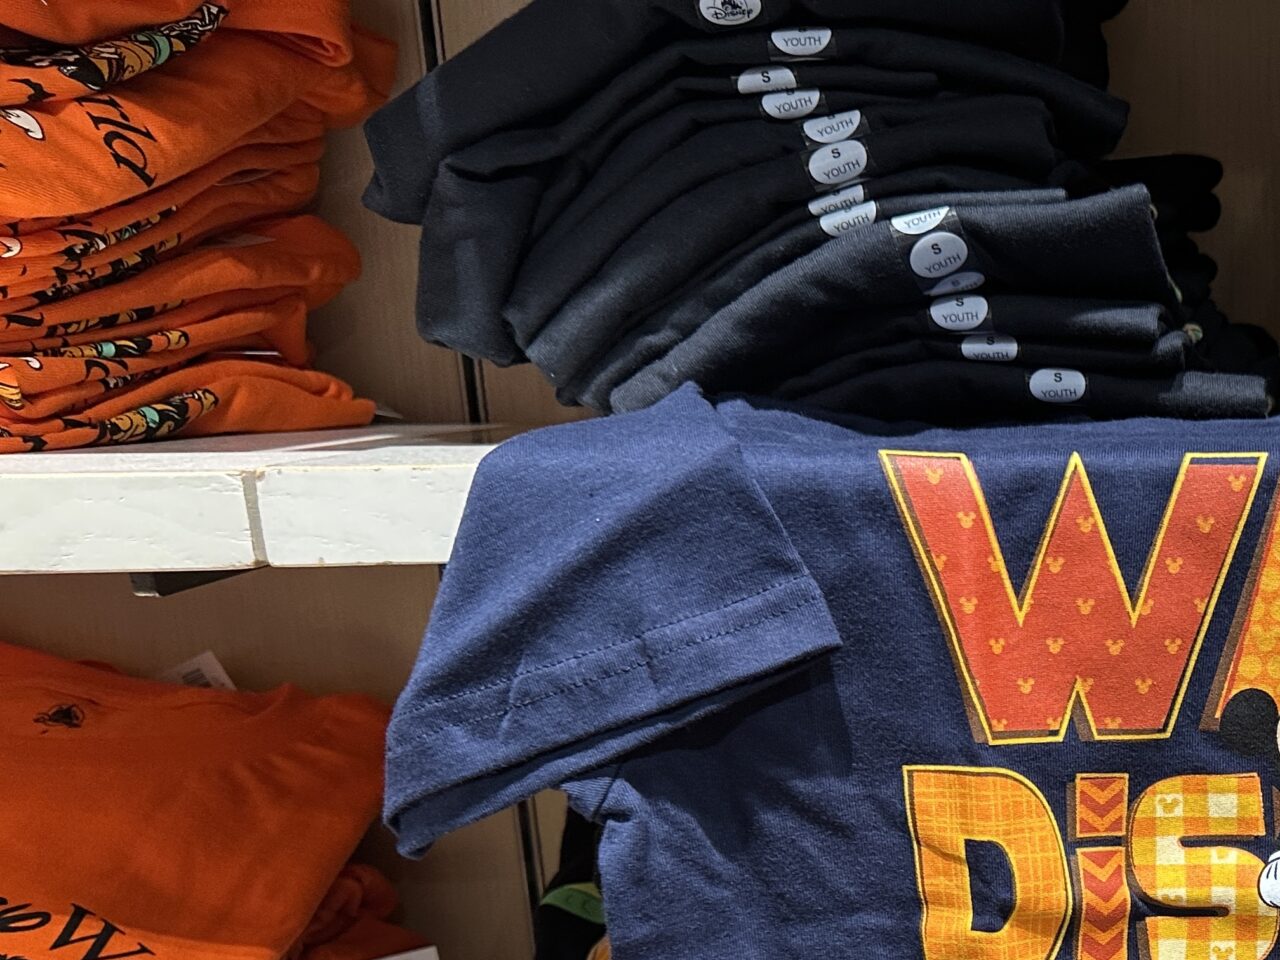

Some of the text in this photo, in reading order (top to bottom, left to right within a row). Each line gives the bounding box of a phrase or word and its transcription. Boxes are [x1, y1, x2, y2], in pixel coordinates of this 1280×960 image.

[783, 36, 822, 47] YOUTH
[761, 70, 771, 83] S
[775, 96, 813, 114] YOUTH
[816, 118, 854, 137] YOUTH
[831, 147, 841, 159] S
[823, 159, 860, 180] YOUTH
[834, 213, 870, 233] YOUTH
[904, 210, 941, 229] YOUTH
[931, 243, 942, 255] S
[925, 254, 961, 274] YOUTH
[956, 297, 965, 307] S
[942, 312, 979, 324] YOUTH
[986, 335, 996, 345] S
[1053, 372, 1063, 383] S
[1040, 388, 1077, 399] YOUTH
